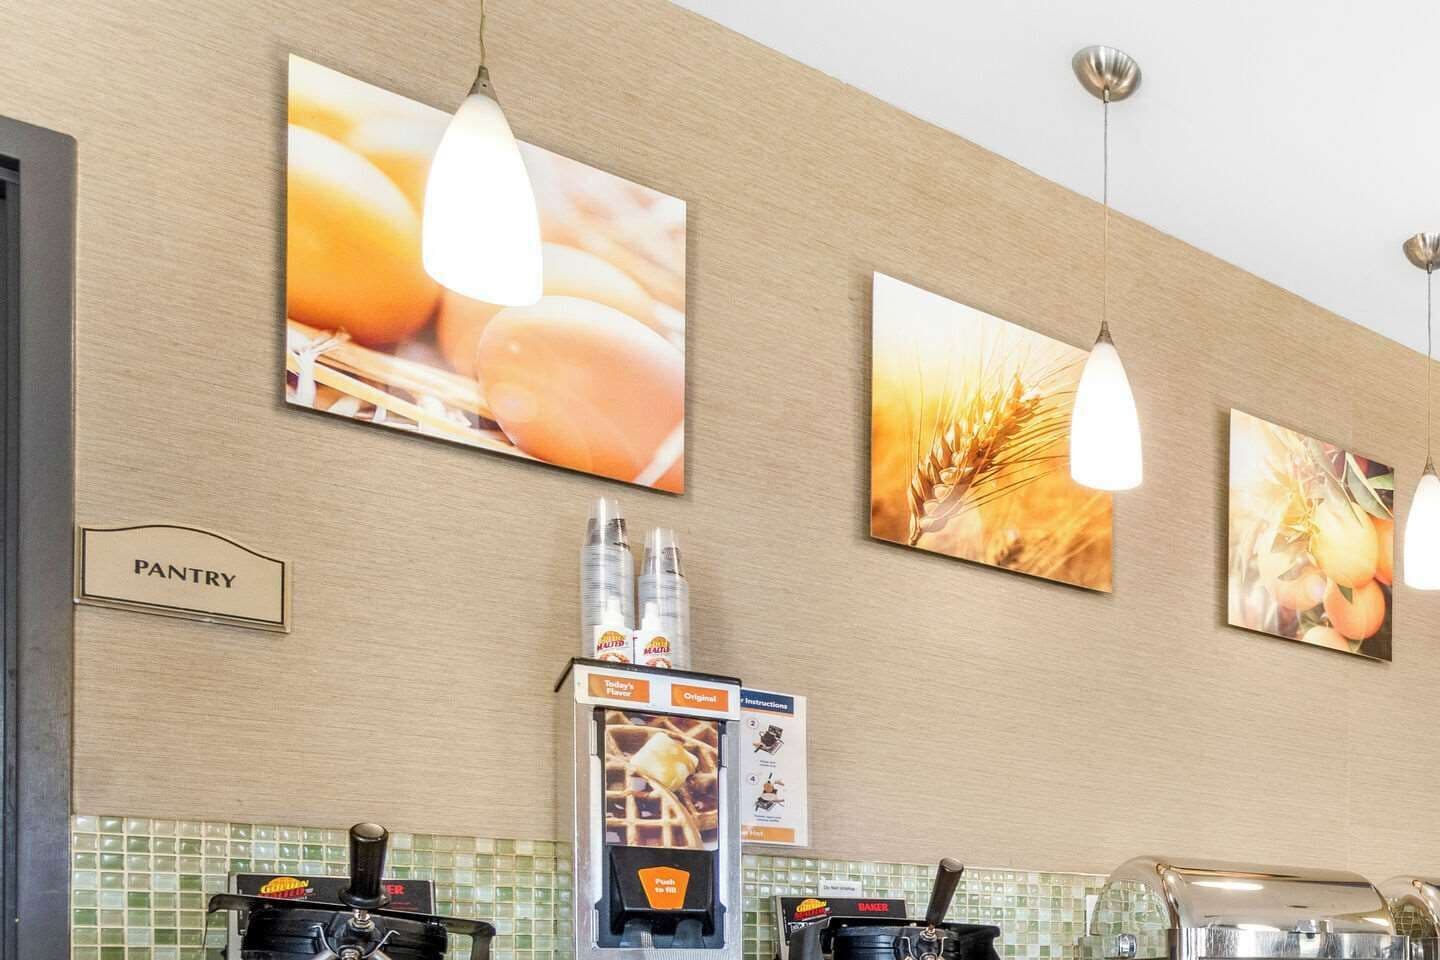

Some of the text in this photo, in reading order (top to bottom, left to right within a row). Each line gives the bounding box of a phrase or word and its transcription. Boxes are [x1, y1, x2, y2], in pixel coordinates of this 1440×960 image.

[134, 559, 236, 589] PANTRY
[604, 680, 634, 691] Today's
[606, 688, 632, 698] Flavor
[683, 692, 717, 704] Original
[745, 697, 788, 711] Instructions
[655, 878, 676, 886] Push
[857, 902, 889, 912] BAKER
